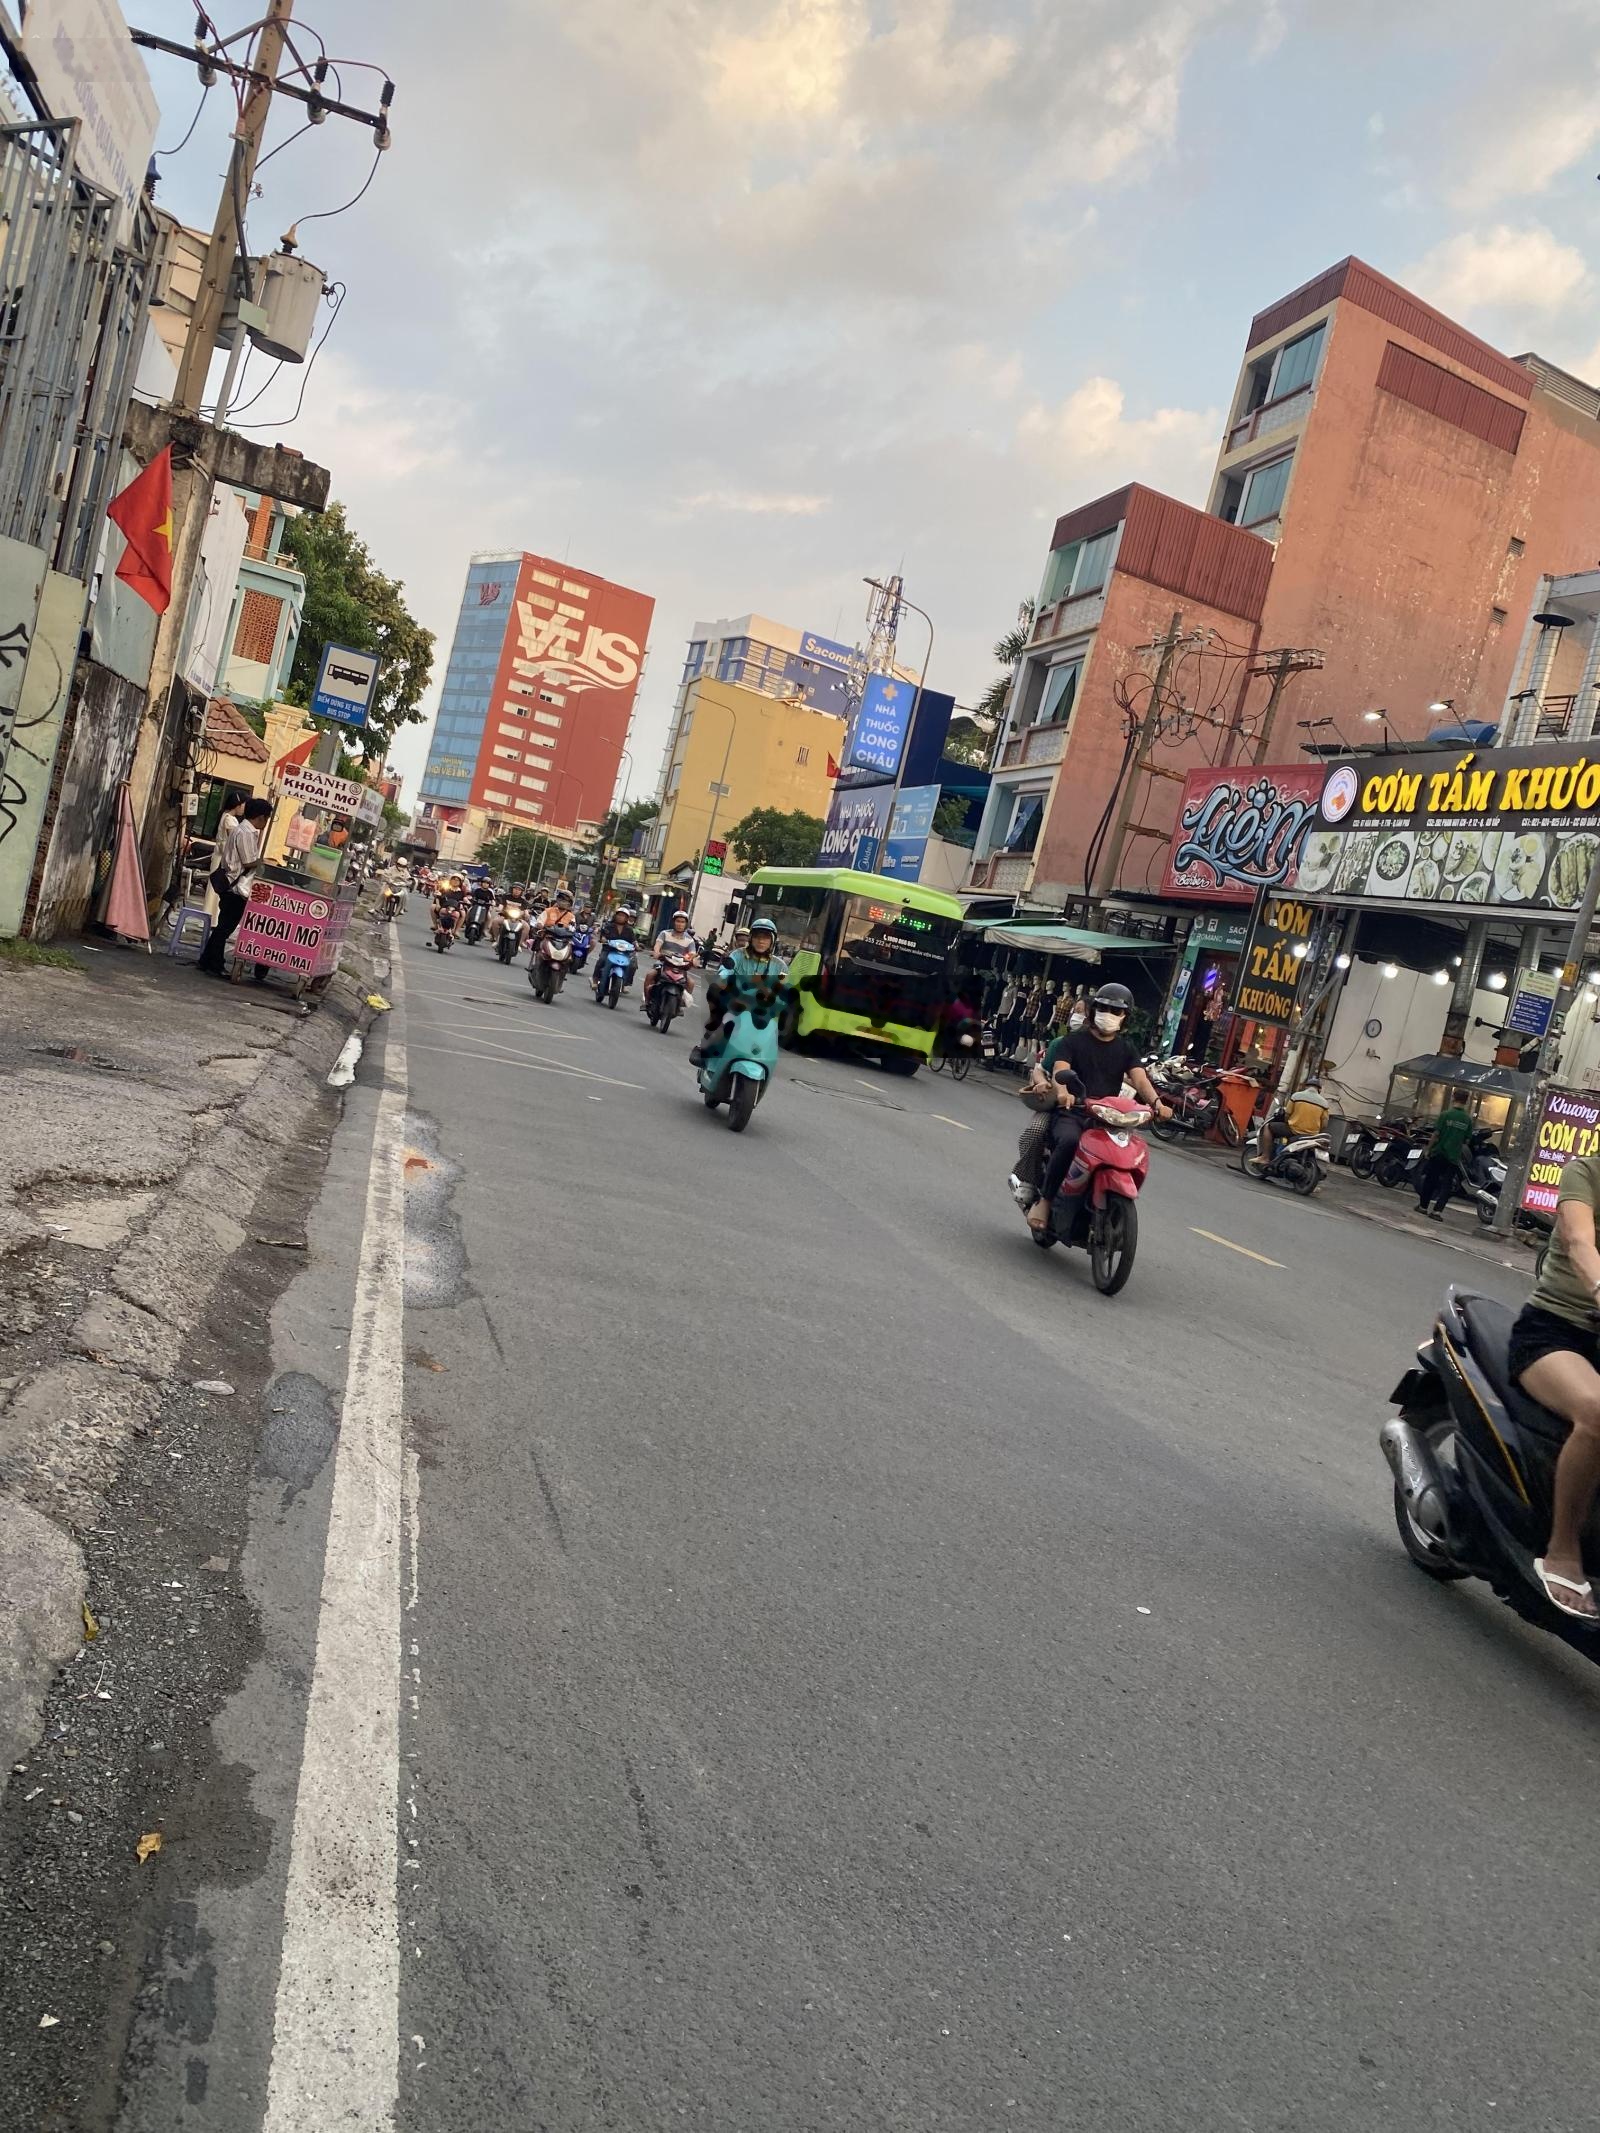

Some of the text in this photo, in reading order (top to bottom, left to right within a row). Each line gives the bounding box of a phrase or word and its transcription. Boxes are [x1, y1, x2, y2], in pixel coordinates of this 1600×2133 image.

[516, 600, 640, 684] VUS
[327, 707, 351, 720] BUS STOP
[875, 703, 896, 717] NHÀ
[866, 717, 900, 734] THUỐC
[860, 731, 897, 750] LONG
[856, 750, 895, 769] CHÂU
[284, 778, 329, 798] KHOAI
[335, 792, 359, 806] MỠ
[303, 771, 347, 791] BÁNH
[1362, 768, 1423, 813] CƠM
[1427, 752, 1496, 812] TẤM
[309, 797, 328, 807] PHÔ
[331, 803, 349, 813] MAI
[854, 797, 875, 818] THUỐC
[821, 830, 849, 853] LONG
[1176, 872, 1210, 888] Barber
[271, 892, 307, 915] BÁNH
[243, 911, 321, 948] KHOAI MỠ
[1264, 899, 1313, 937] CƠM
[238, 938, 312, 971] LẮC PHÔ MAI
[1251, 938, 1301, 985] TẤM
[1239, 987, 1292, 1019] KHƯƠNG
[1539, 1120, 1577, 1153] CƠM
